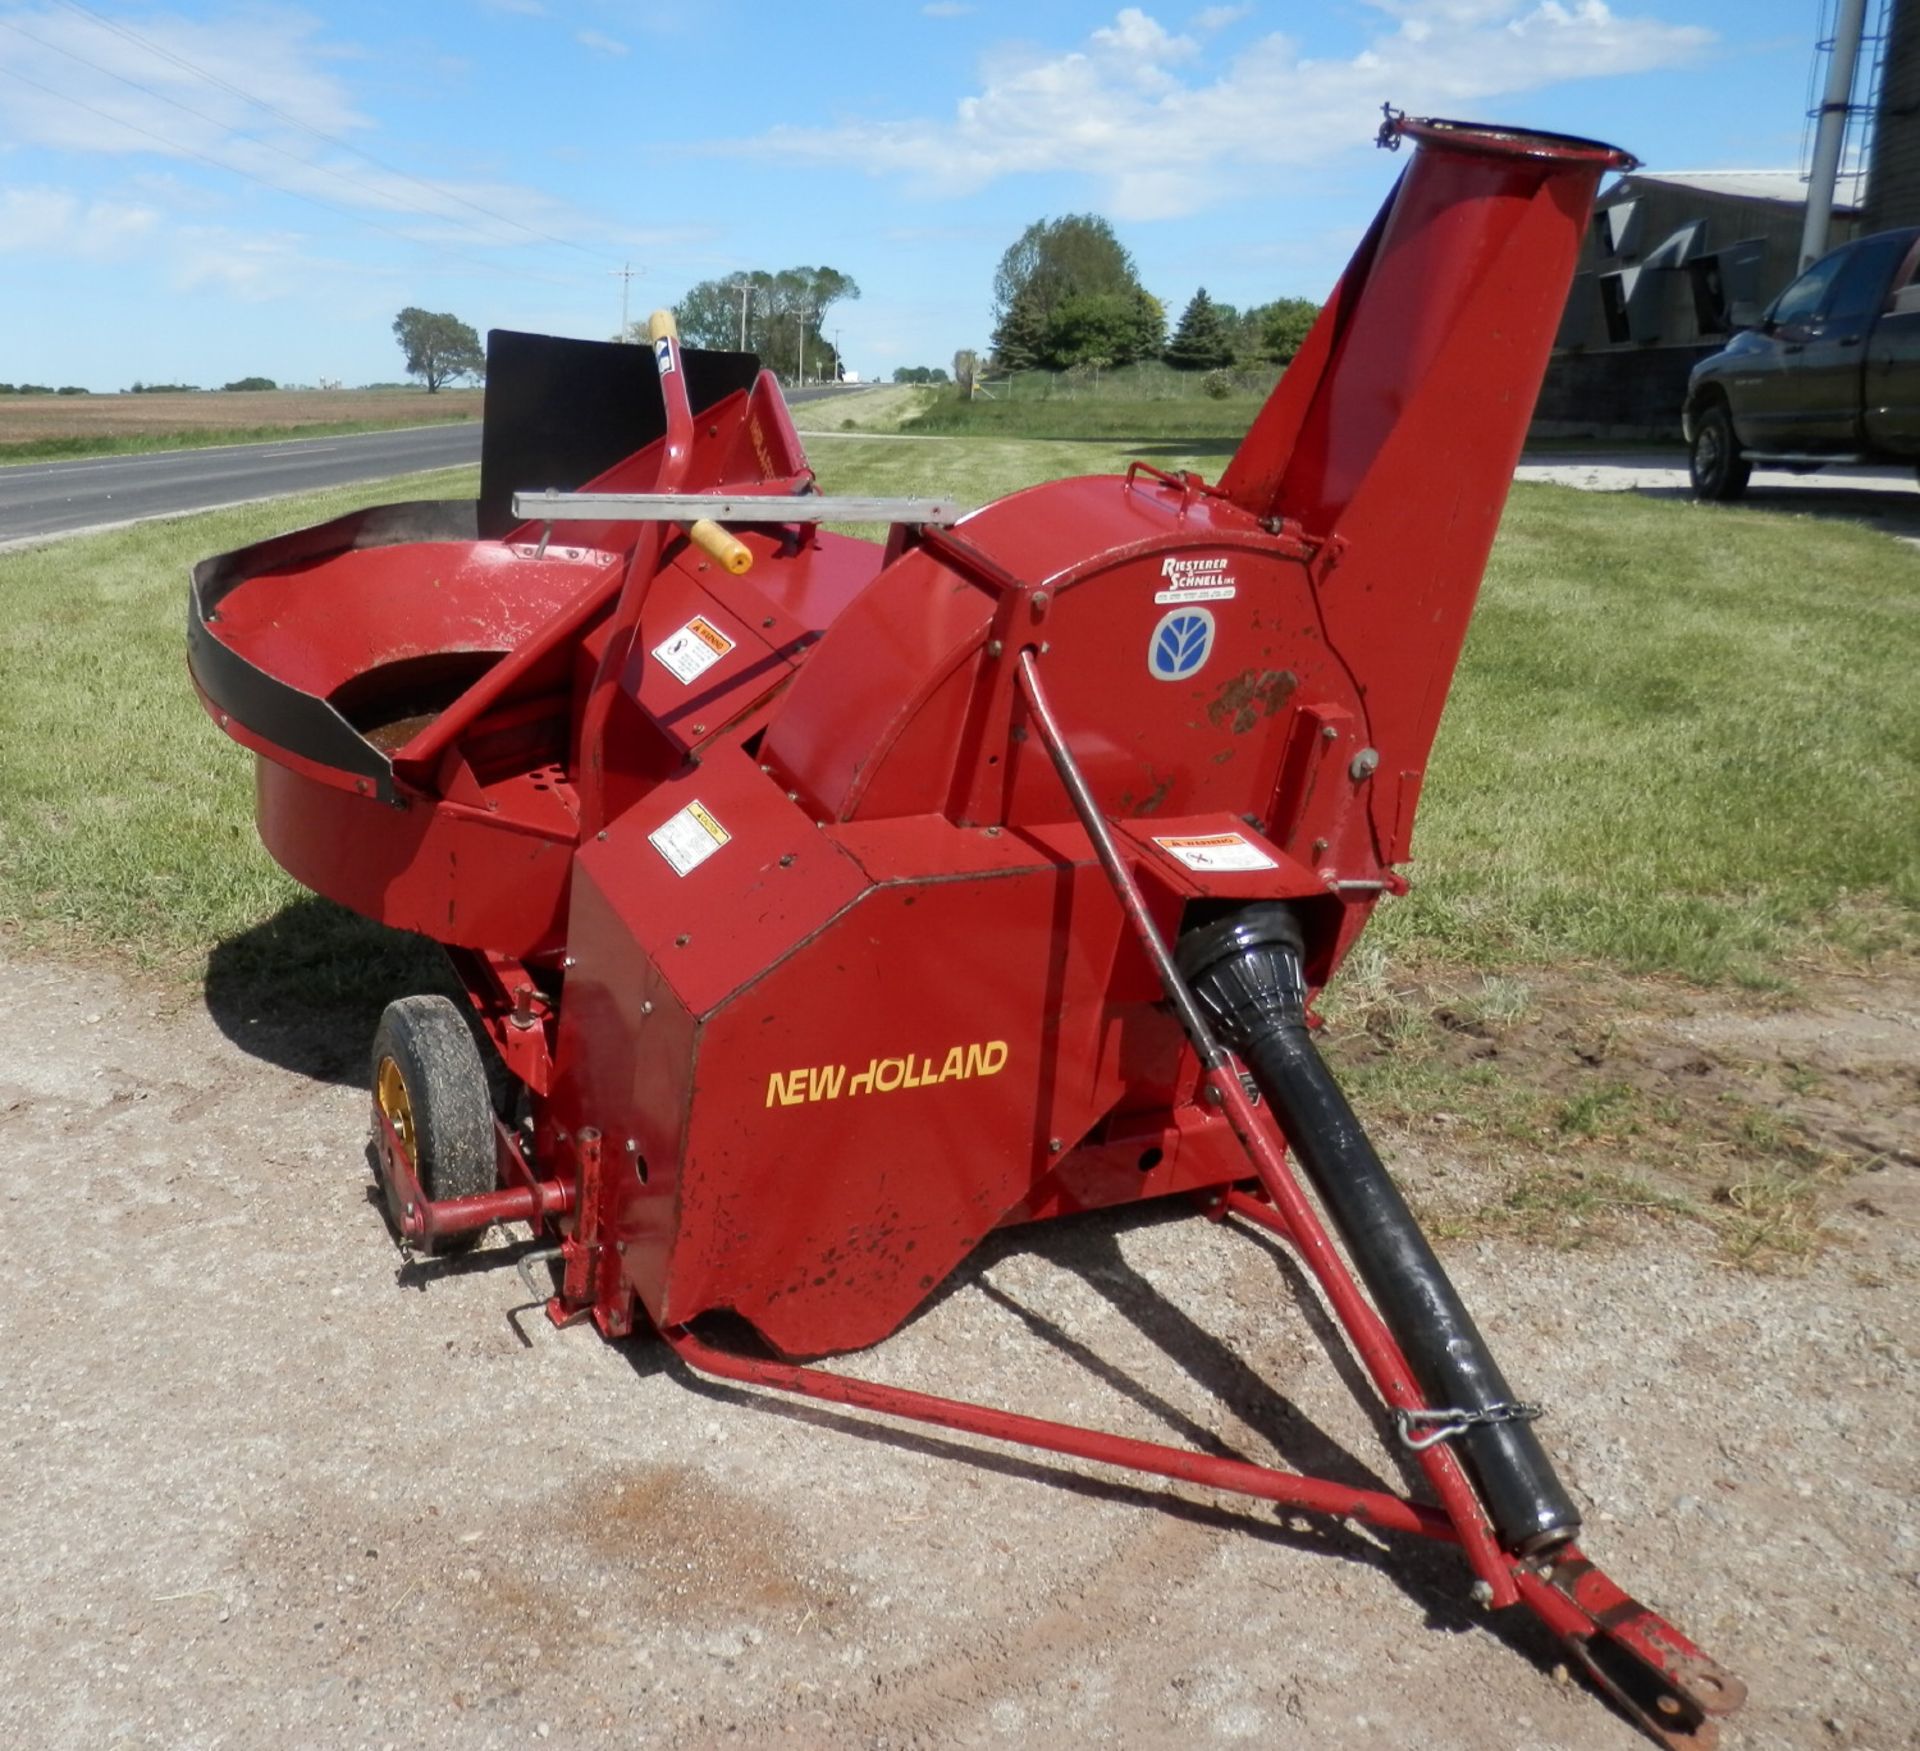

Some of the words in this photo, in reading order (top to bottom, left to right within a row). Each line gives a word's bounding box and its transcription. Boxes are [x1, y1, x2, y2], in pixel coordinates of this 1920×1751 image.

[1161, 558, 1228, 576] RIESTERER
[1169, 574, 1223, 590] SCHNELL
[766, 1064, 846, 1108] NEW
[849, 1040, 1009, 1097] HOLLAND
